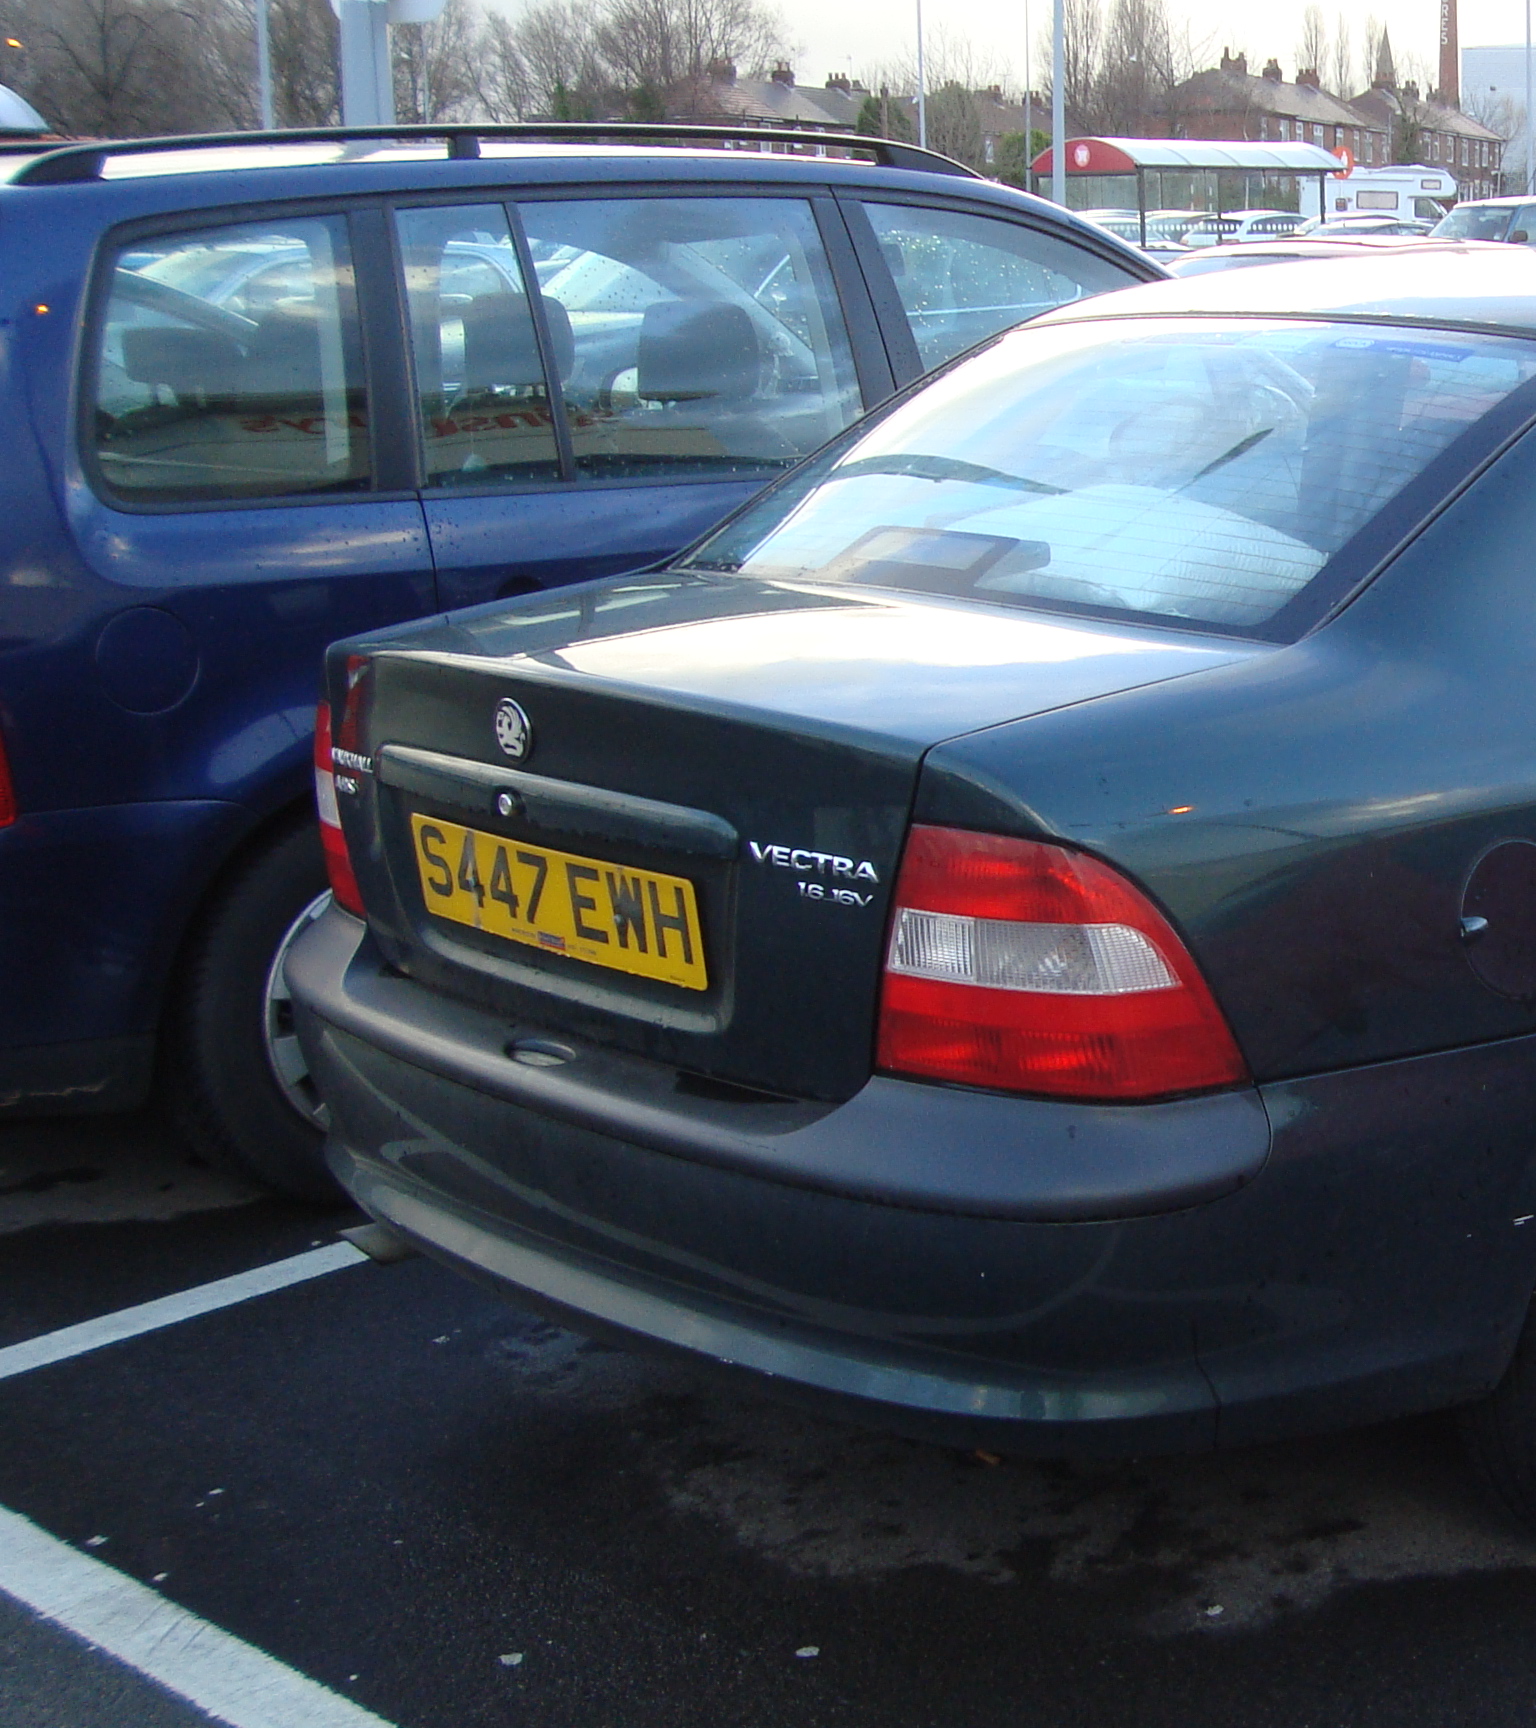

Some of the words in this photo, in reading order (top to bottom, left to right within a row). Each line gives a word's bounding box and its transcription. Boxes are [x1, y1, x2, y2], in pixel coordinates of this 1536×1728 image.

[1441, 0, 1449, 45] RES
[749, 840, 880, 884] VECTRA
[420, 824, 548, 924] S447
[565, 862, 693, 965] EWH
[831, 888, 874, 907] 16V
